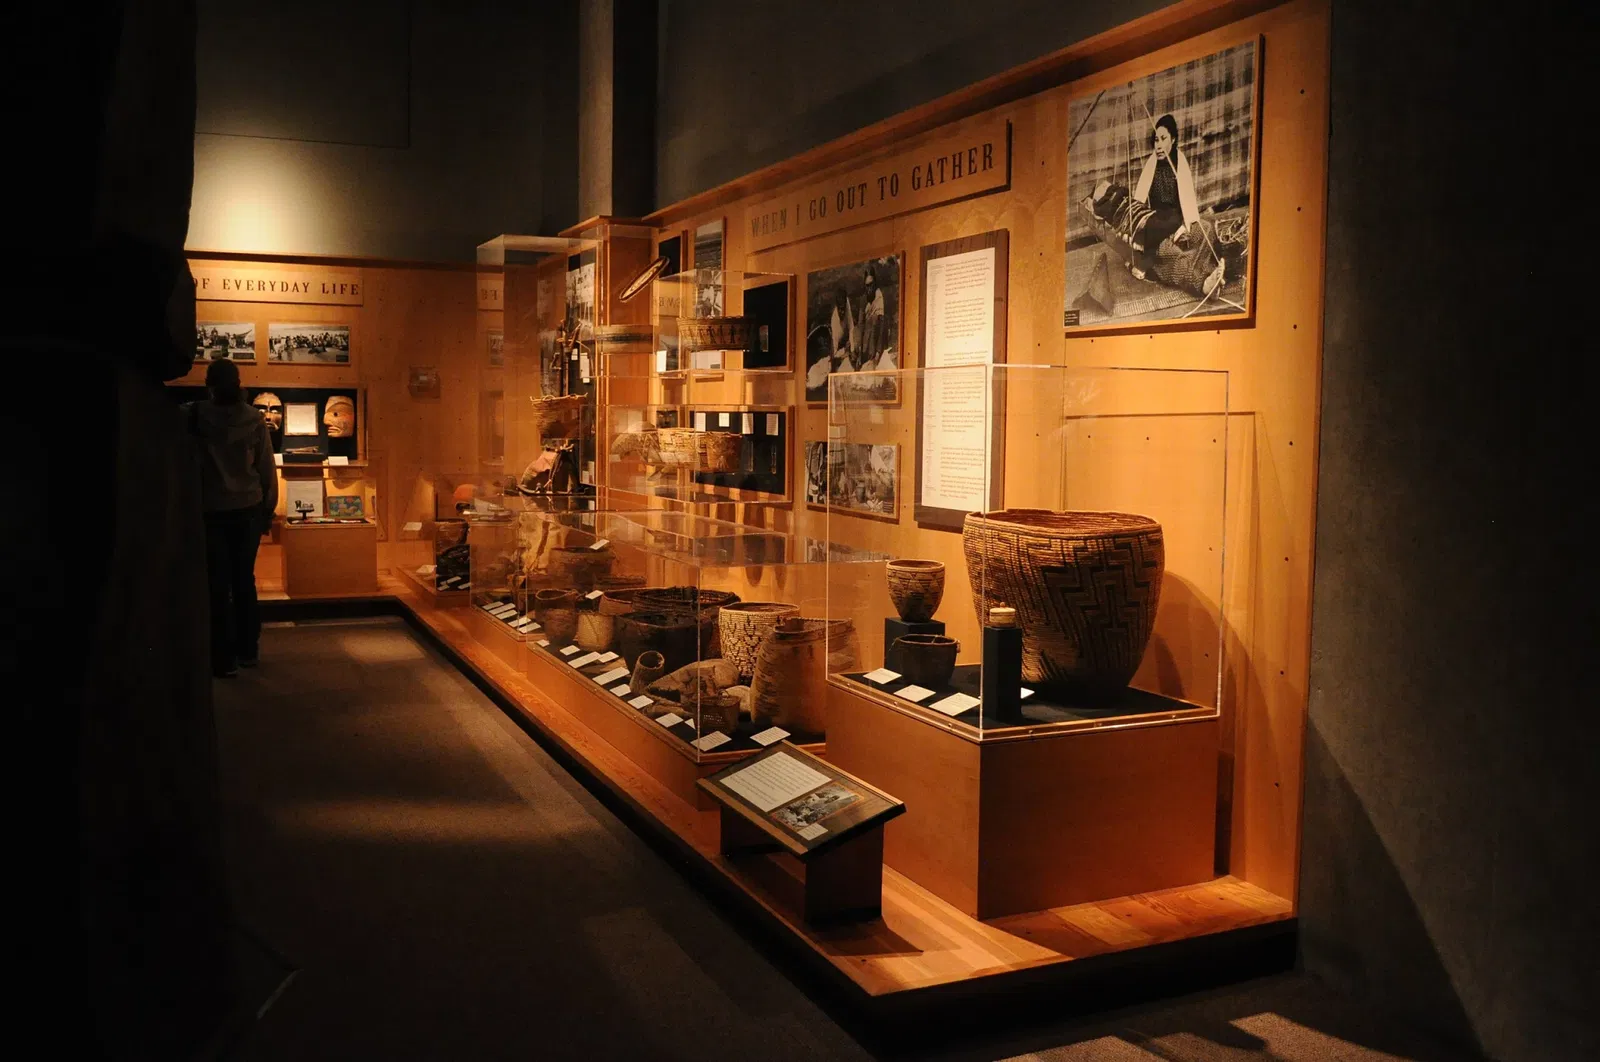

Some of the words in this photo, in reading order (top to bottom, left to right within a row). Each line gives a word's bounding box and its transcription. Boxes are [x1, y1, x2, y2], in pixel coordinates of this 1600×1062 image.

[751, 208, 787, 238] WHEN
[795, 204, 801, 225] I
[809, 196, 827, 221] GO
[836, 182, 867, 213] OUT
[877, 172, 899, 201] TO
[911, 143, 994, 191] GATHER
[223, 278, 310, 293] EVERYDAY
[322, 283, 359, 295] LIFE
